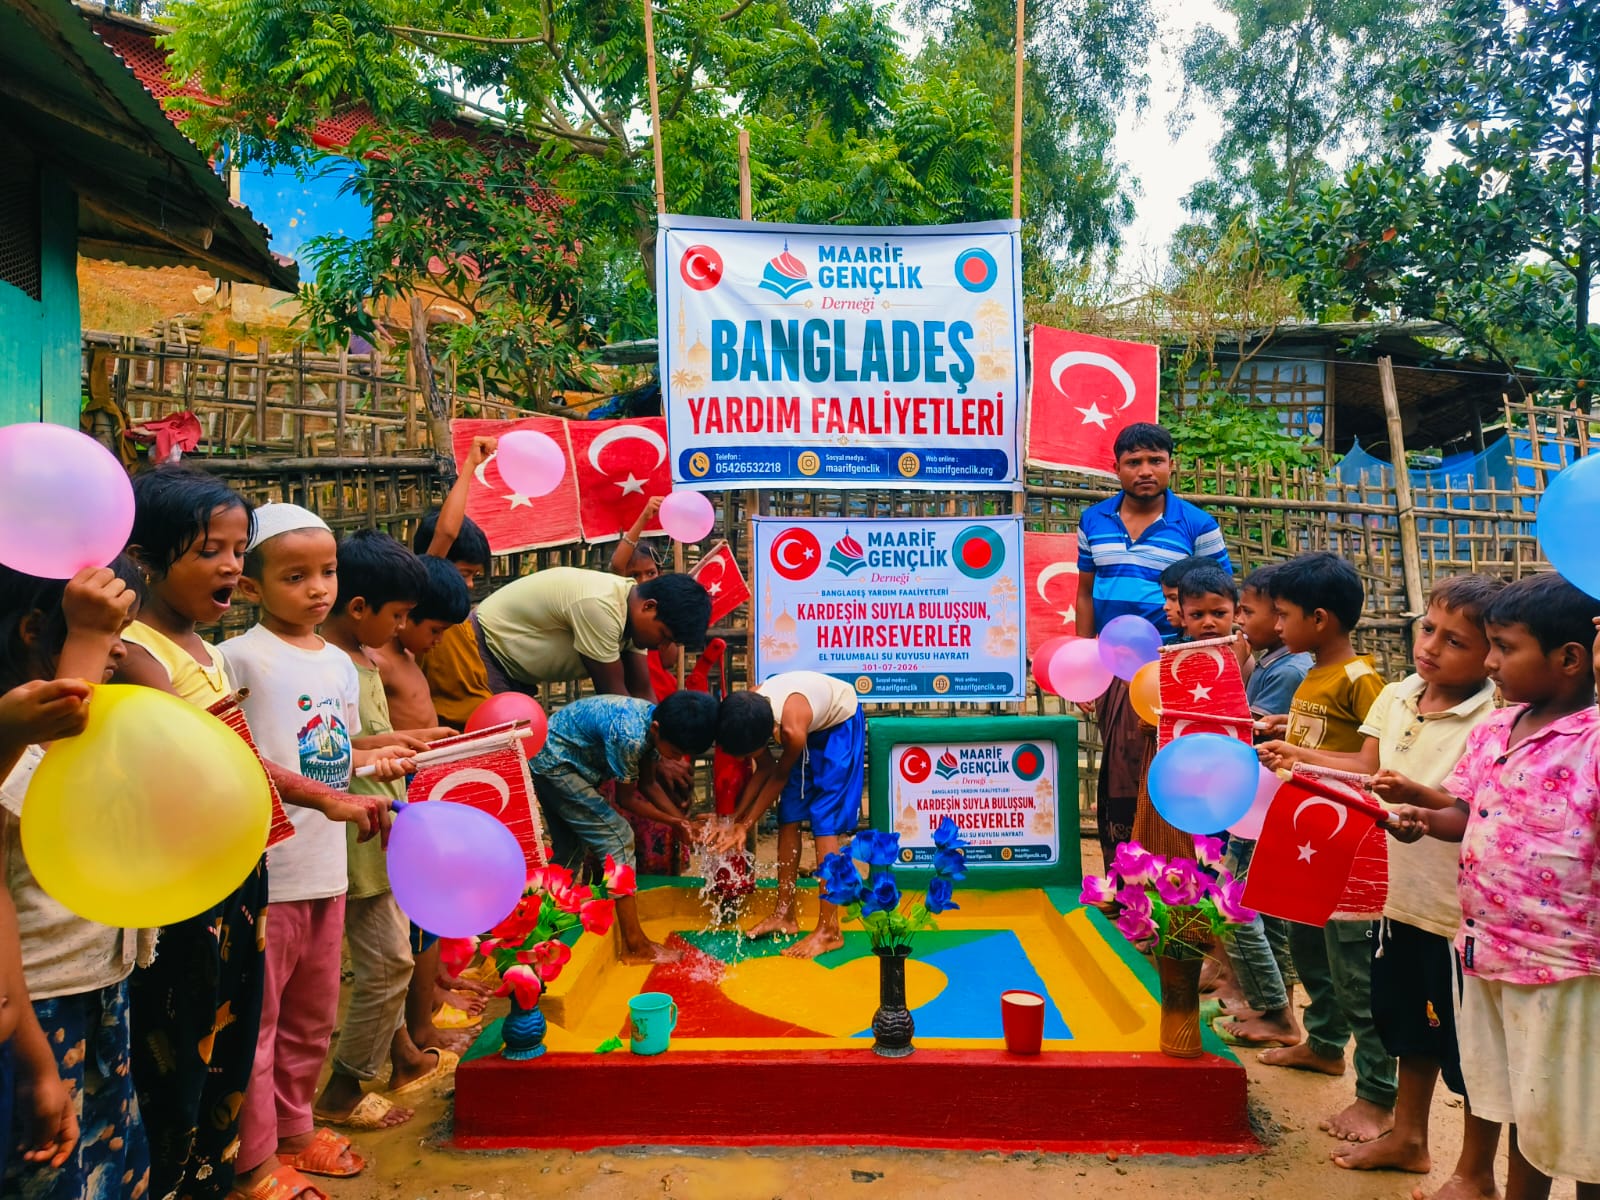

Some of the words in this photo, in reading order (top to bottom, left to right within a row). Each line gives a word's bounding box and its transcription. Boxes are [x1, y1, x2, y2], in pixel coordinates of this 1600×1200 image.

[818, 242, 903, 262] MAARİF
[818, 262, 923, 294] GENÇLİK
[821, 296, 875, 314] Derneği
[711, 318, 975, 394] BANGLADEŞ
[688, 396, 801, 435] YARDIM
[811, 390, 1004, 436] FAALİYETLERİ
[715, 462, 782, 473] 05426532218
[825, 463, 880, 474] maarifgenclik
[925, 465, 993, 476] maarifgenclik.org
[868, 528, 936, 547] MAARİF
[868, 546, 948, 572] GENÇLİK
[871, 572, 910, 585] Derneği
[821, 590, 866, 598] BANGLADEŞ
[899, 588, 949, 596] FAALİYETLERİ
[797, 599, 867, 623] KARDEŞİN
[871, 602, 915, 619] SUYLA
[919, 601, 991, 623] BULUŞSUN,
[817, 624, 971, 648] HAYIRSEVERLER
[818, 653, 828, 661] EL
[831, 653, 879, 661] TULUMBALI
[882, 652, 893, 661] SU
[896, 652, 930, 660] KUYUSU
[933, 652, 969, 660] HAYRATI
[960, 746, 1002, 760] MAARİF
[960, 759, 1009, 776] GENÇLİK
[917, 796, 960, 813] KARDEŞİN
[963, 797, 989, 810] SUYLA
[992, 796, 1036, 811] BULUŞSUN,
[929, 812, 1025, 830] HIRSEVERLER
